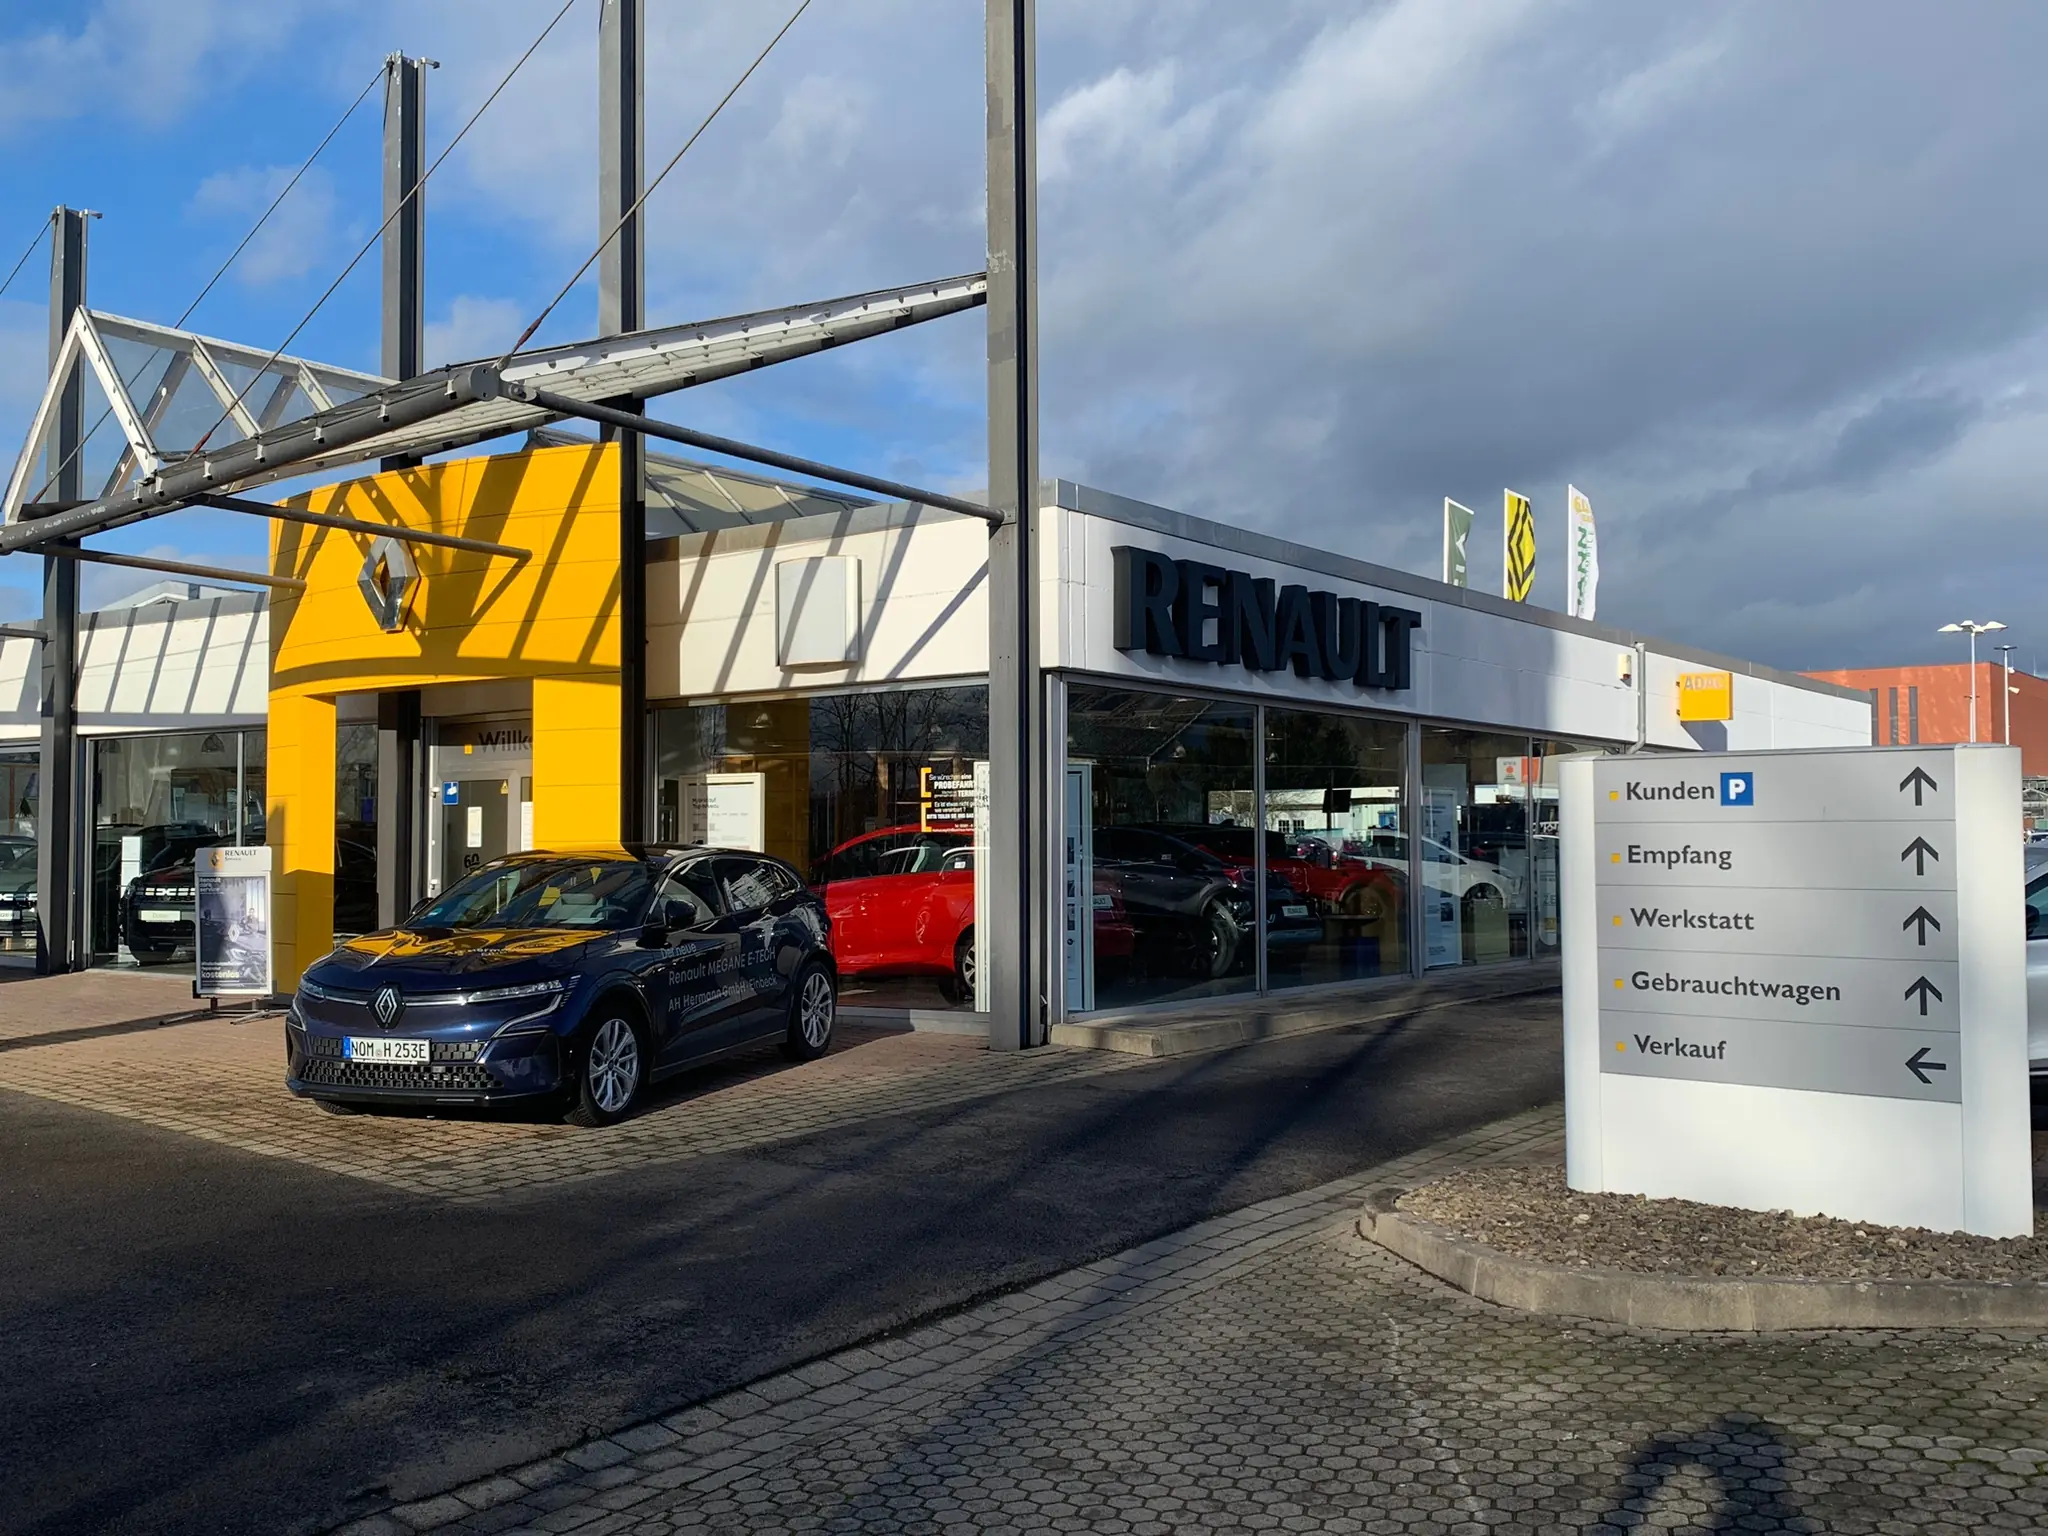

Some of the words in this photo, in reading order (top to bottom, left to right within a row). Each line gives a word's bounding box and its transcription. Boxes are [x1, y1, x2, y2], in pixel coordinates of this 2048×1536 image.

[1110, 545, 1422, 690] RENAULT
[1684, 675, 1726, 692] ADAC
[478, 729, 533, 753] Willk
[1626, 781, 1715, 801] Kunden
[1728, 778, 1746, 801] P
[224, 849, 257, 857] RENAULT
[1627, 844, 1733, 870] Empfang
[1630, 907, 1755, 931] Werkstatt
[660, 946, 675, 960] Der
[675, 943, 697, 956] neue
[668, 963, 706, 986] Renault
[748, 946, 776, 966] E-TECH
[668, 997, 681, 1012] AH
[683, 987, 722, 1007] Hermann
[722, 980, 746, 997] GmbH
[749, 973, 778, 991] Einbeck
[1631, 970, 1841, 1006] Gebrauchtwagen
[351, 1041, 374, 1057] NOM
[383, 1042, 391, 1058] H
[395, 1043, 426, 1059] 253E
[1633, 1034, 1728, 1060] Verkauf
